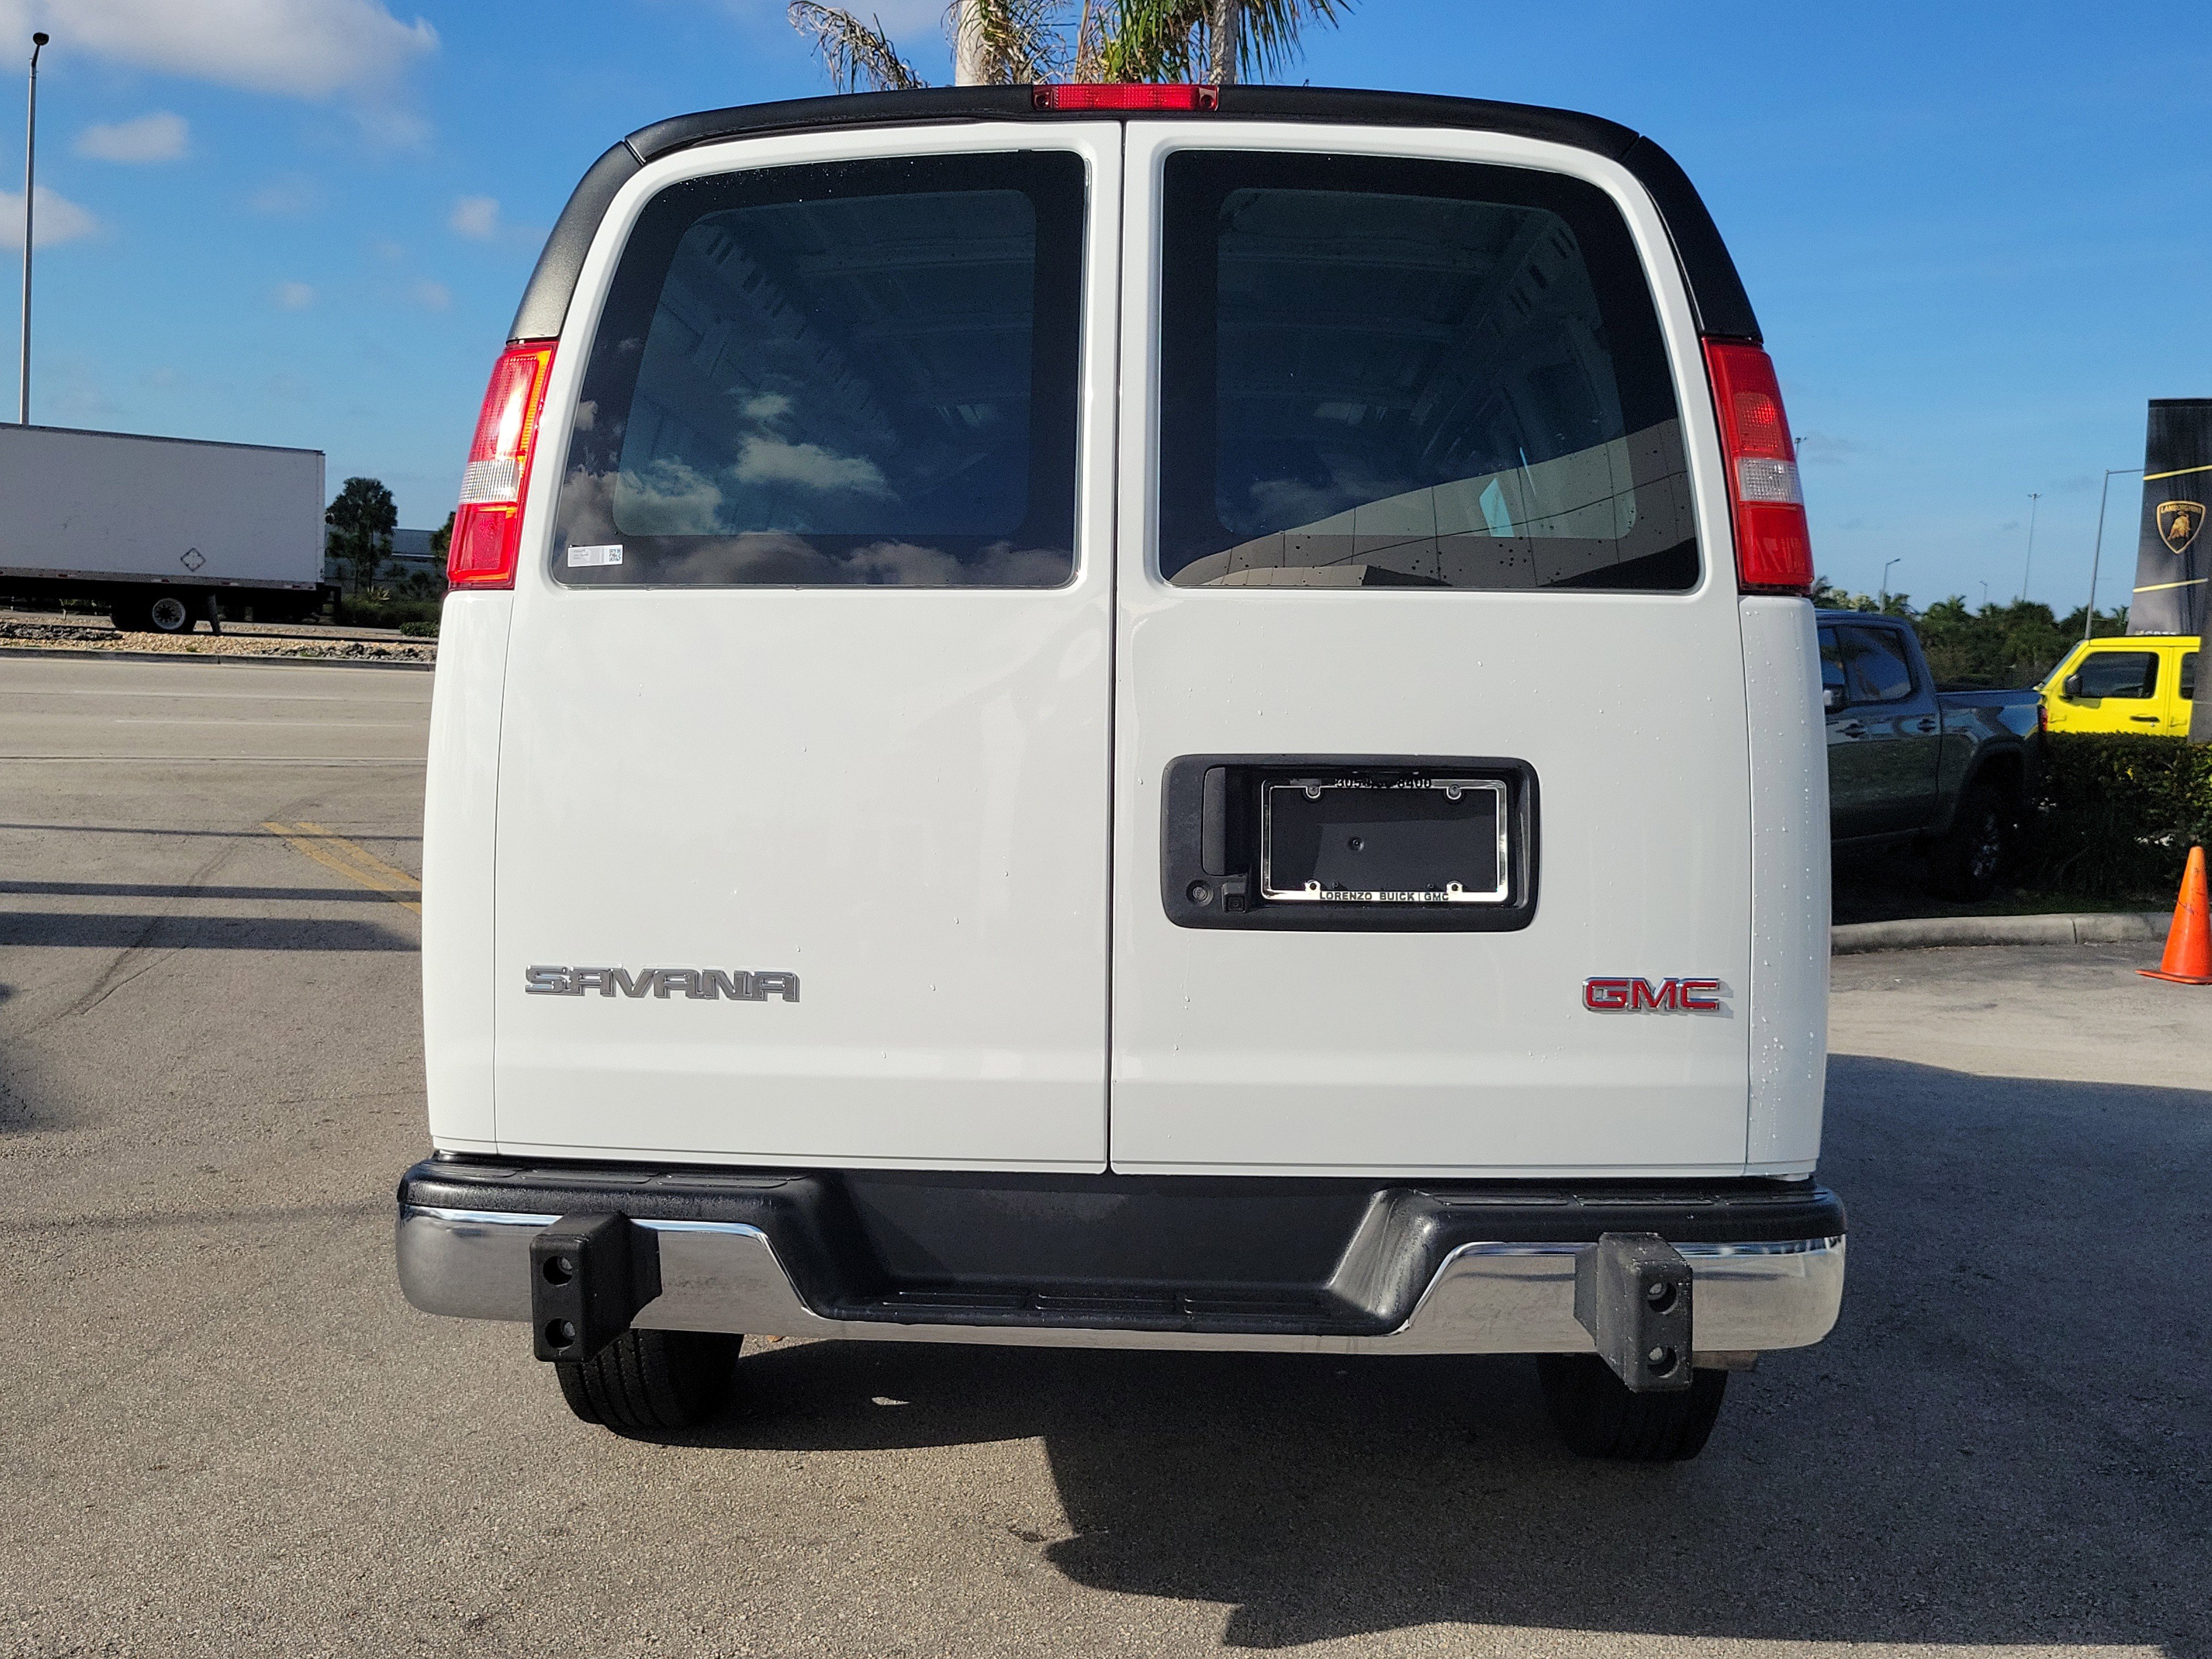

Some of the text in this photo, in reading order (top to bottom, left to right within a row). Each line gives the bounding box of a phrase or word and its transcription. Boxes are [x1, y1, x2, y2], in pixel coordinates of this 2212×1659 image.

[1319, 891, 1449, 901] LORENZO BUICK GMC
[525, 964, 800, 1003] SAVANA
[1582, 976, 1720, 1013] GMC
